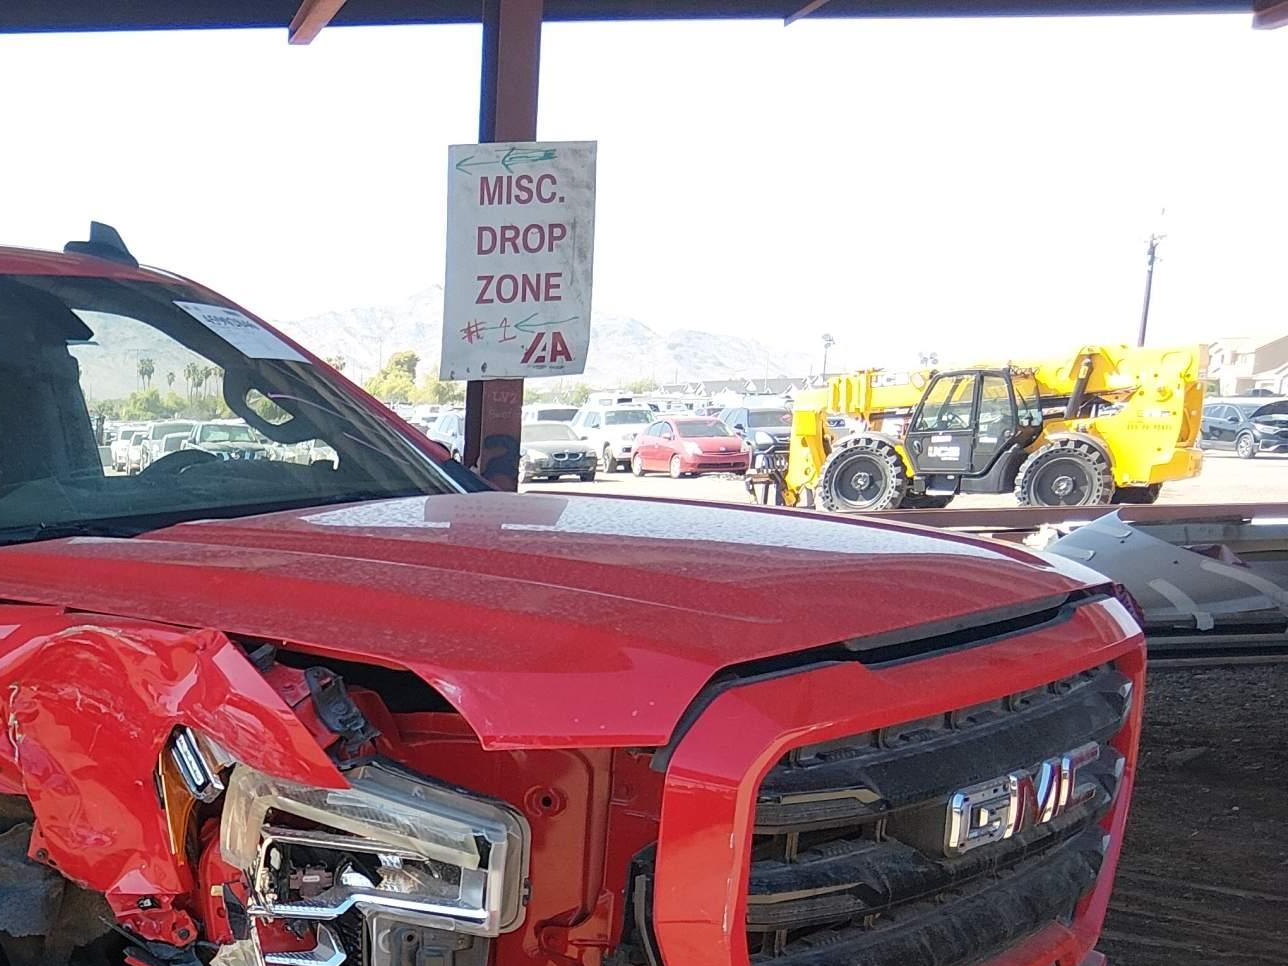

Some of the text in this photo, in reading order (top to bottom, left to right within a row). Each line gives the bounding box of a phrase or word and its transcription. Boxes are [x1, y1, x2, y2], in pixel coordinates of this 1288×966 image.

[479, 174, 565, 206] MISC.
[477, 223, 567, 255] DROP
[475, 272, 563, 305] ZONE
[944, 741, 1100, 857] GMC
